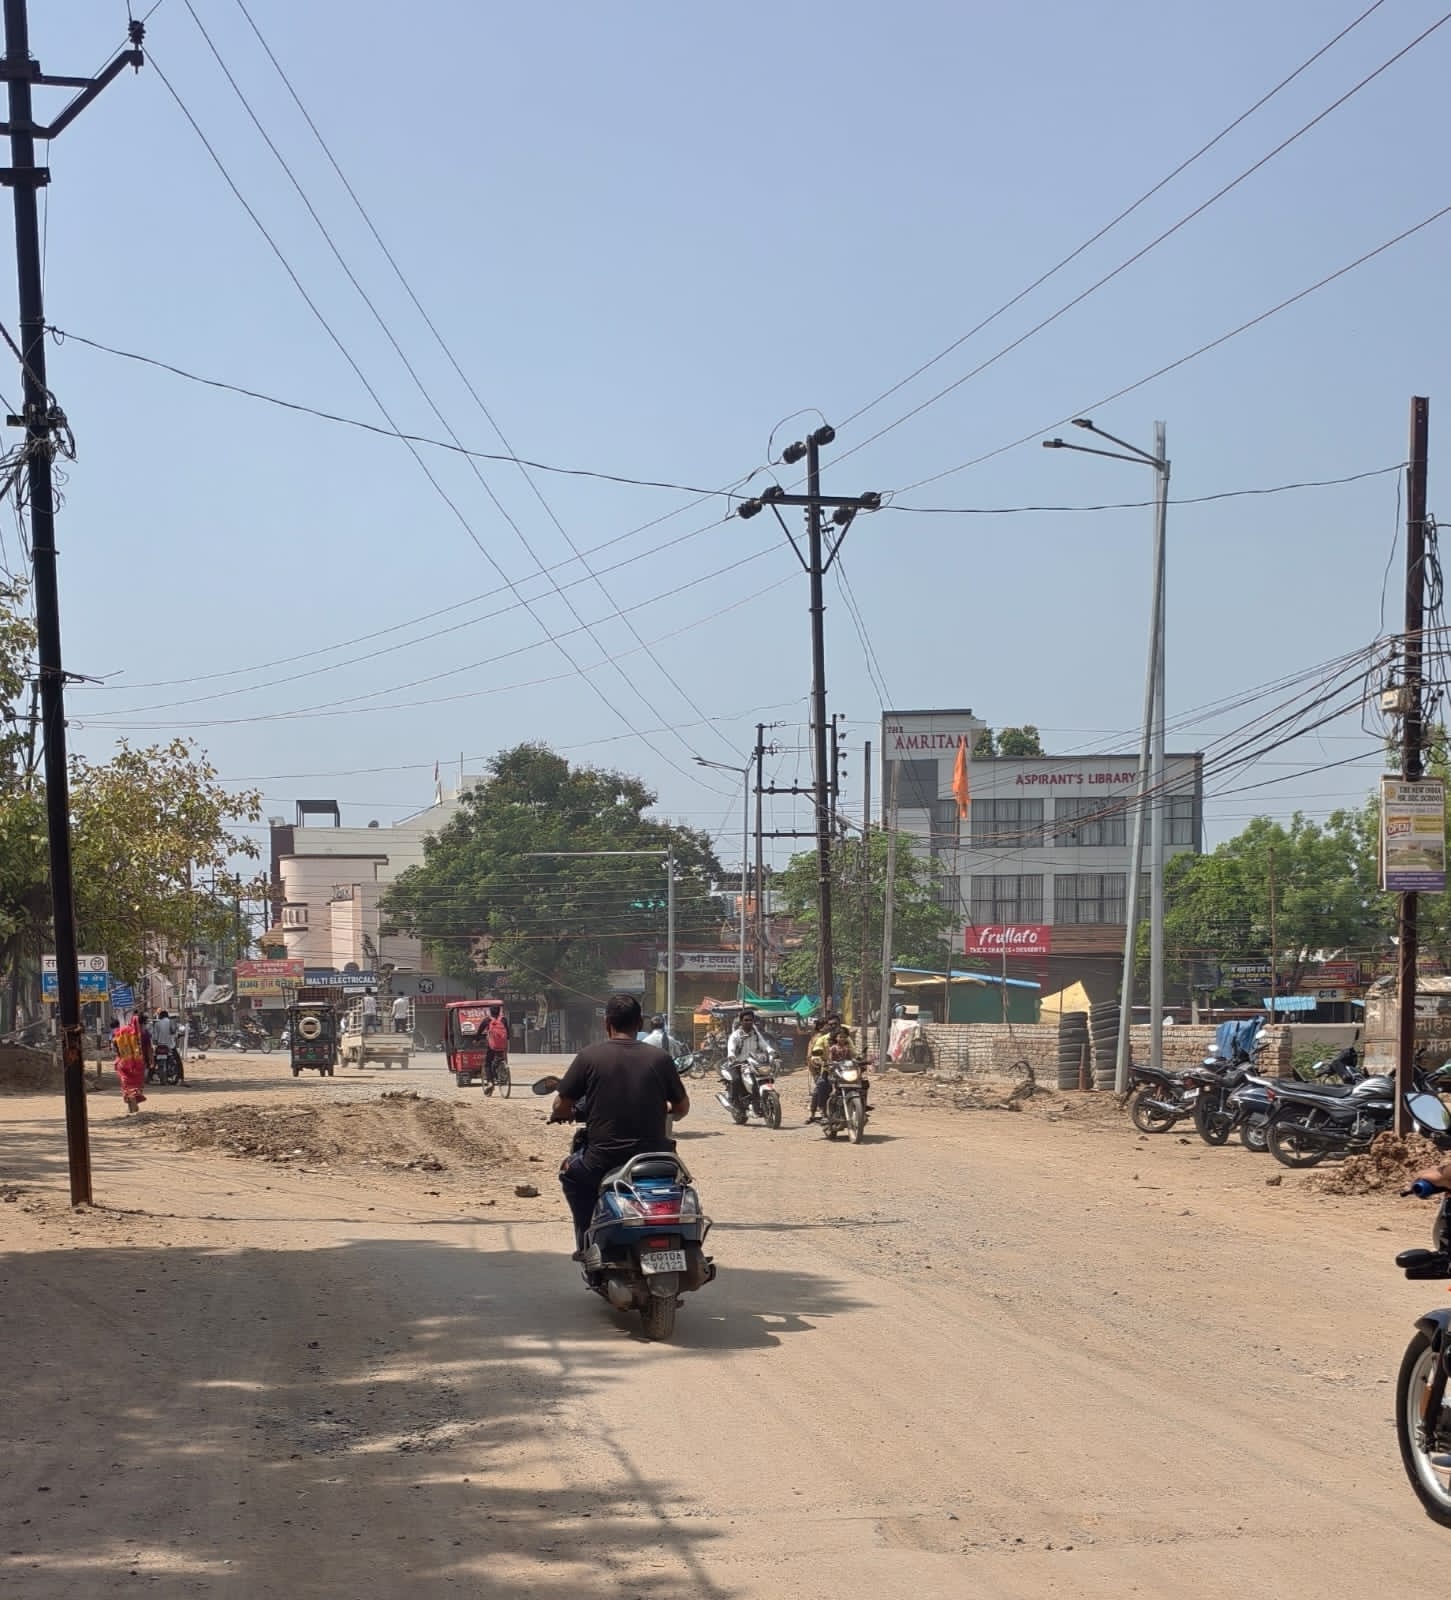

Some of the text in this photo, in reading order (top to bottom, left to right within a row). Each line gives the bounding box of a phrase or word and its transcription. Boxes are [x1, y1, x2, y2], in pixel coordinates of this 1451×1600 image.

[887, 726, 904, 734] THE
[895, 734, 969, 750] AMRITAM
[1015, 772, 1137, 785] ASPIRANT'S LIBRARY
[979, 927, 1038, 946] frullato
[306, 977, 328, 985] MALTI
[329, 975, 377, 985] ELECTRICALS
